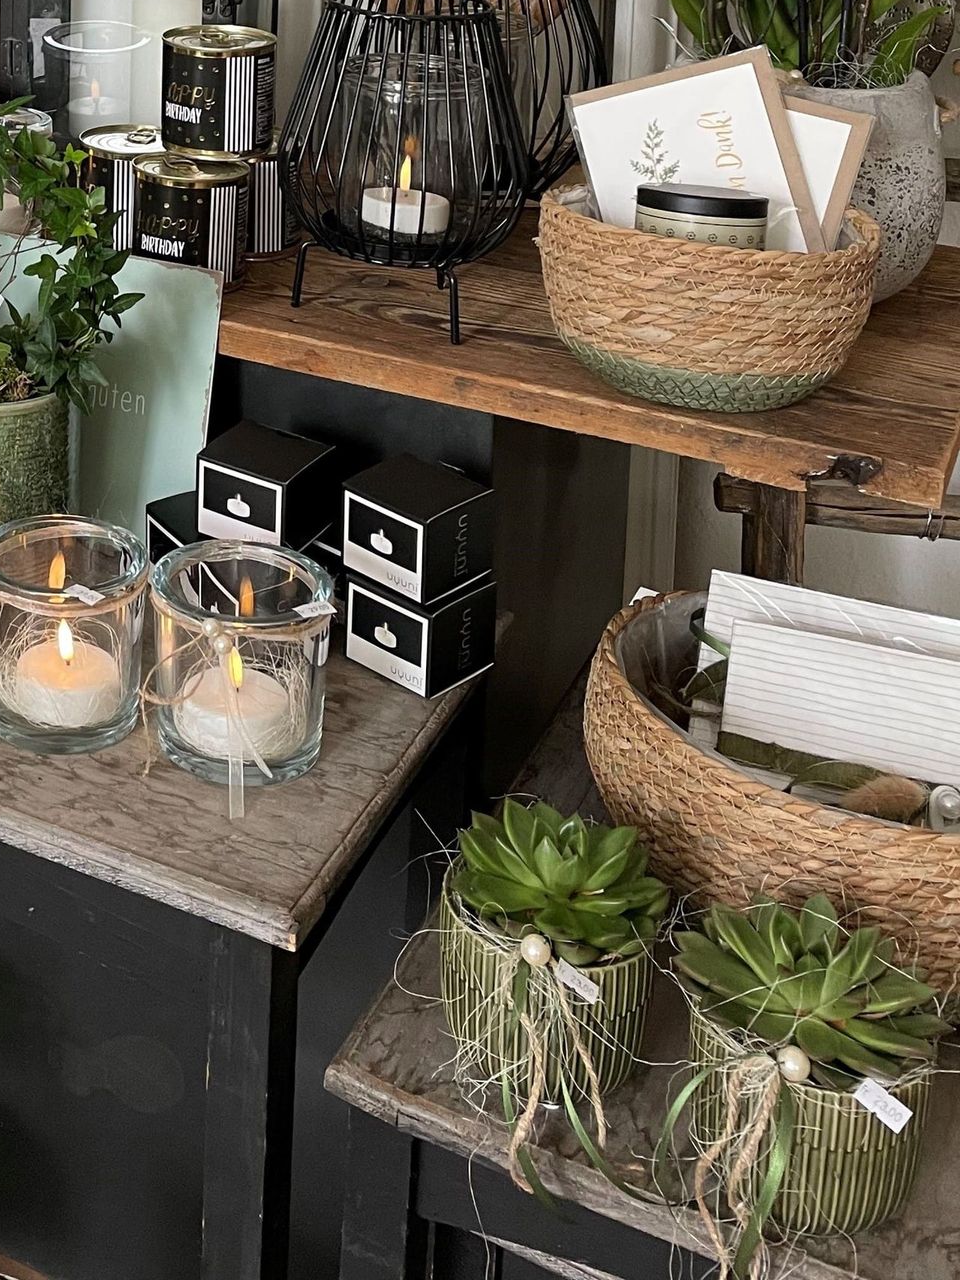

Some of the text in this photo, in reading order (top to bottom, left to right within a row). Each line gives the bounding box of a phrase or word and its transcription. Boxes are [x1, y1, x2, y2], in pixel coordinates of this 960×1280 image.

[165, 100, 202, 124] BIRTHDAY
[696, 110, 743, 170] Dank!
[141, 233, 186, 258] BIRTHDAY
